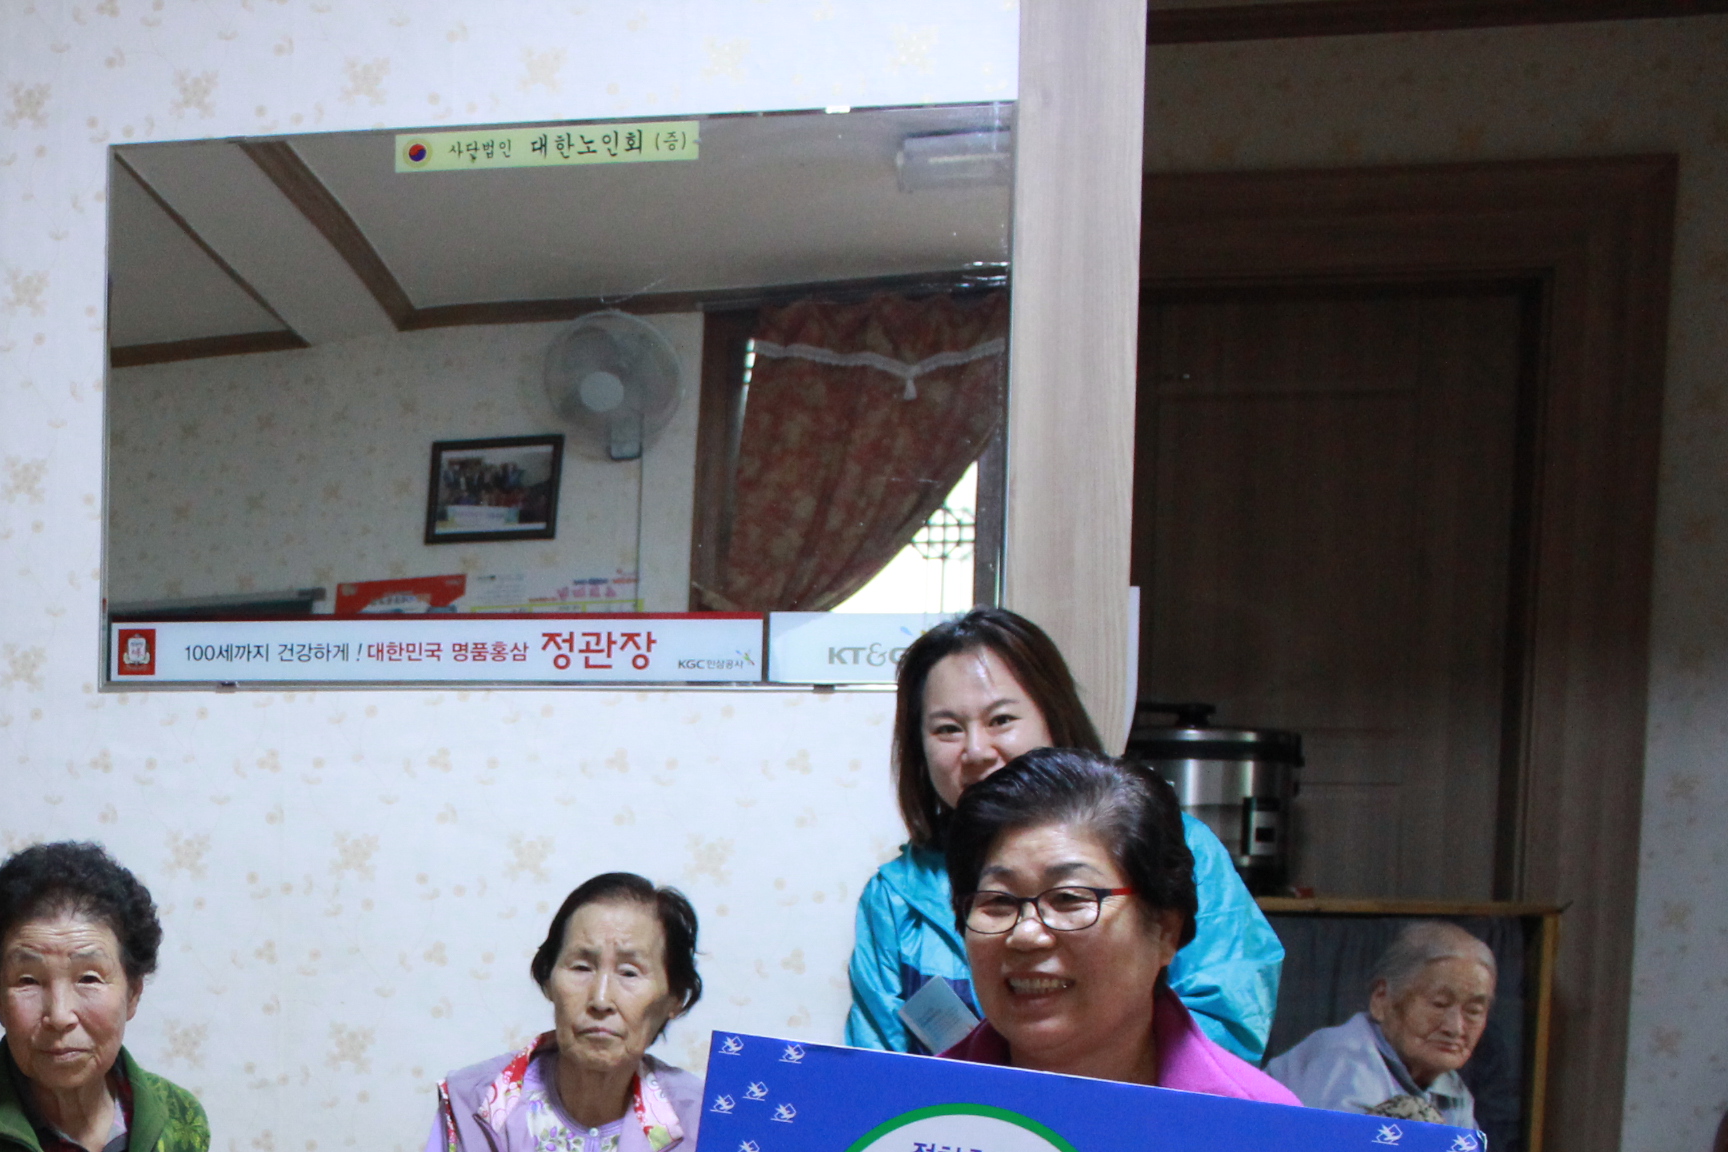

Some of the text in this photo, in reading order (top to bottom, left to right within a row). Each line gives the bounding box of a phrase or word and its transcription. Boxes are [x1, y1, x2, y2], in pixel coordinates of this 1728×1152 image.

[530, 130, 643, 160] 대한노인회
[184, 643, 269, 662] 100세까지
[278, 643, 349, 662] 건강하게
[367, 641, 443, 662] 대한민국
[452, 641, 529, 662] 명품홍삼
[541, 631, 657, 670] 정관장
